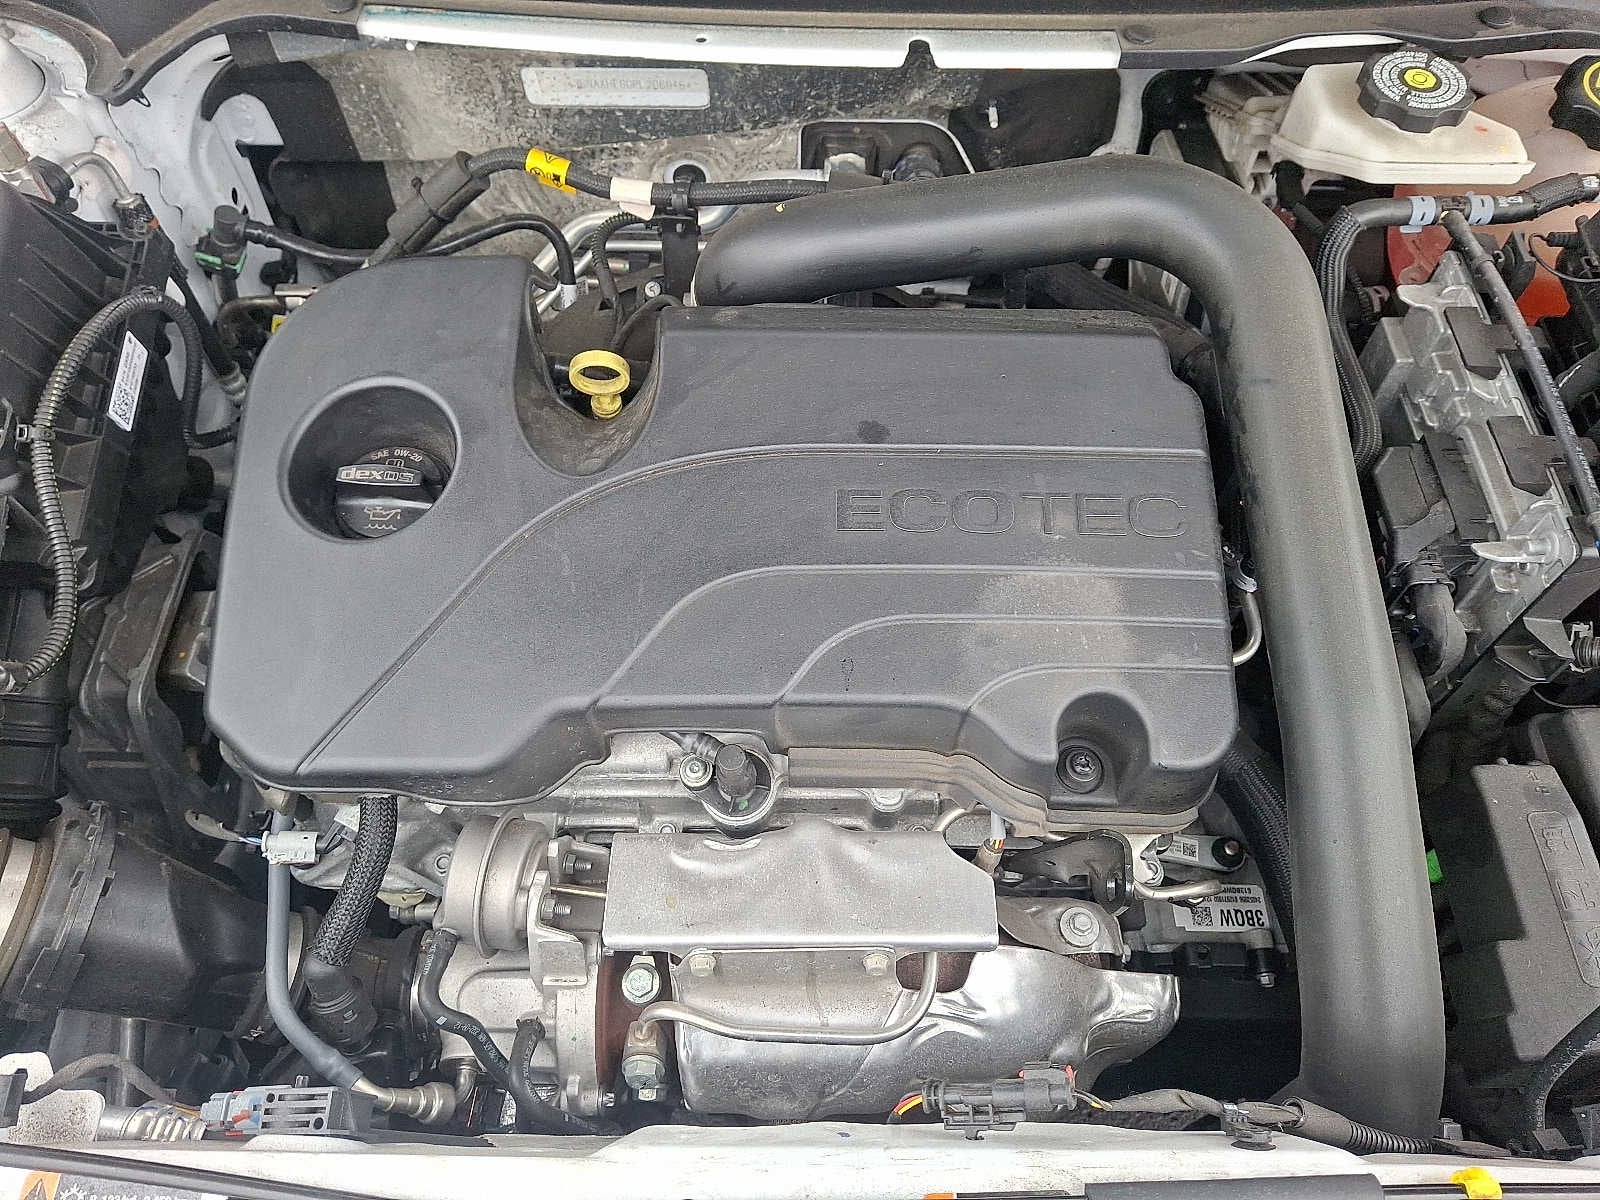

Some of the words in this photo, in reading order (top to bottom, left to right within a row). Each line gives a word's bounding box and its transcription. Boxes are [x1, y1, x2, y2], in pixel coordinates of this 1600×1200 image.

[371, 449, 390, 460] SAE
[341, 467, 415, 483] dexos
[835, 488, 1187, 538] ECOTEC
[1220, 908, 1265, 927] 3BQW
